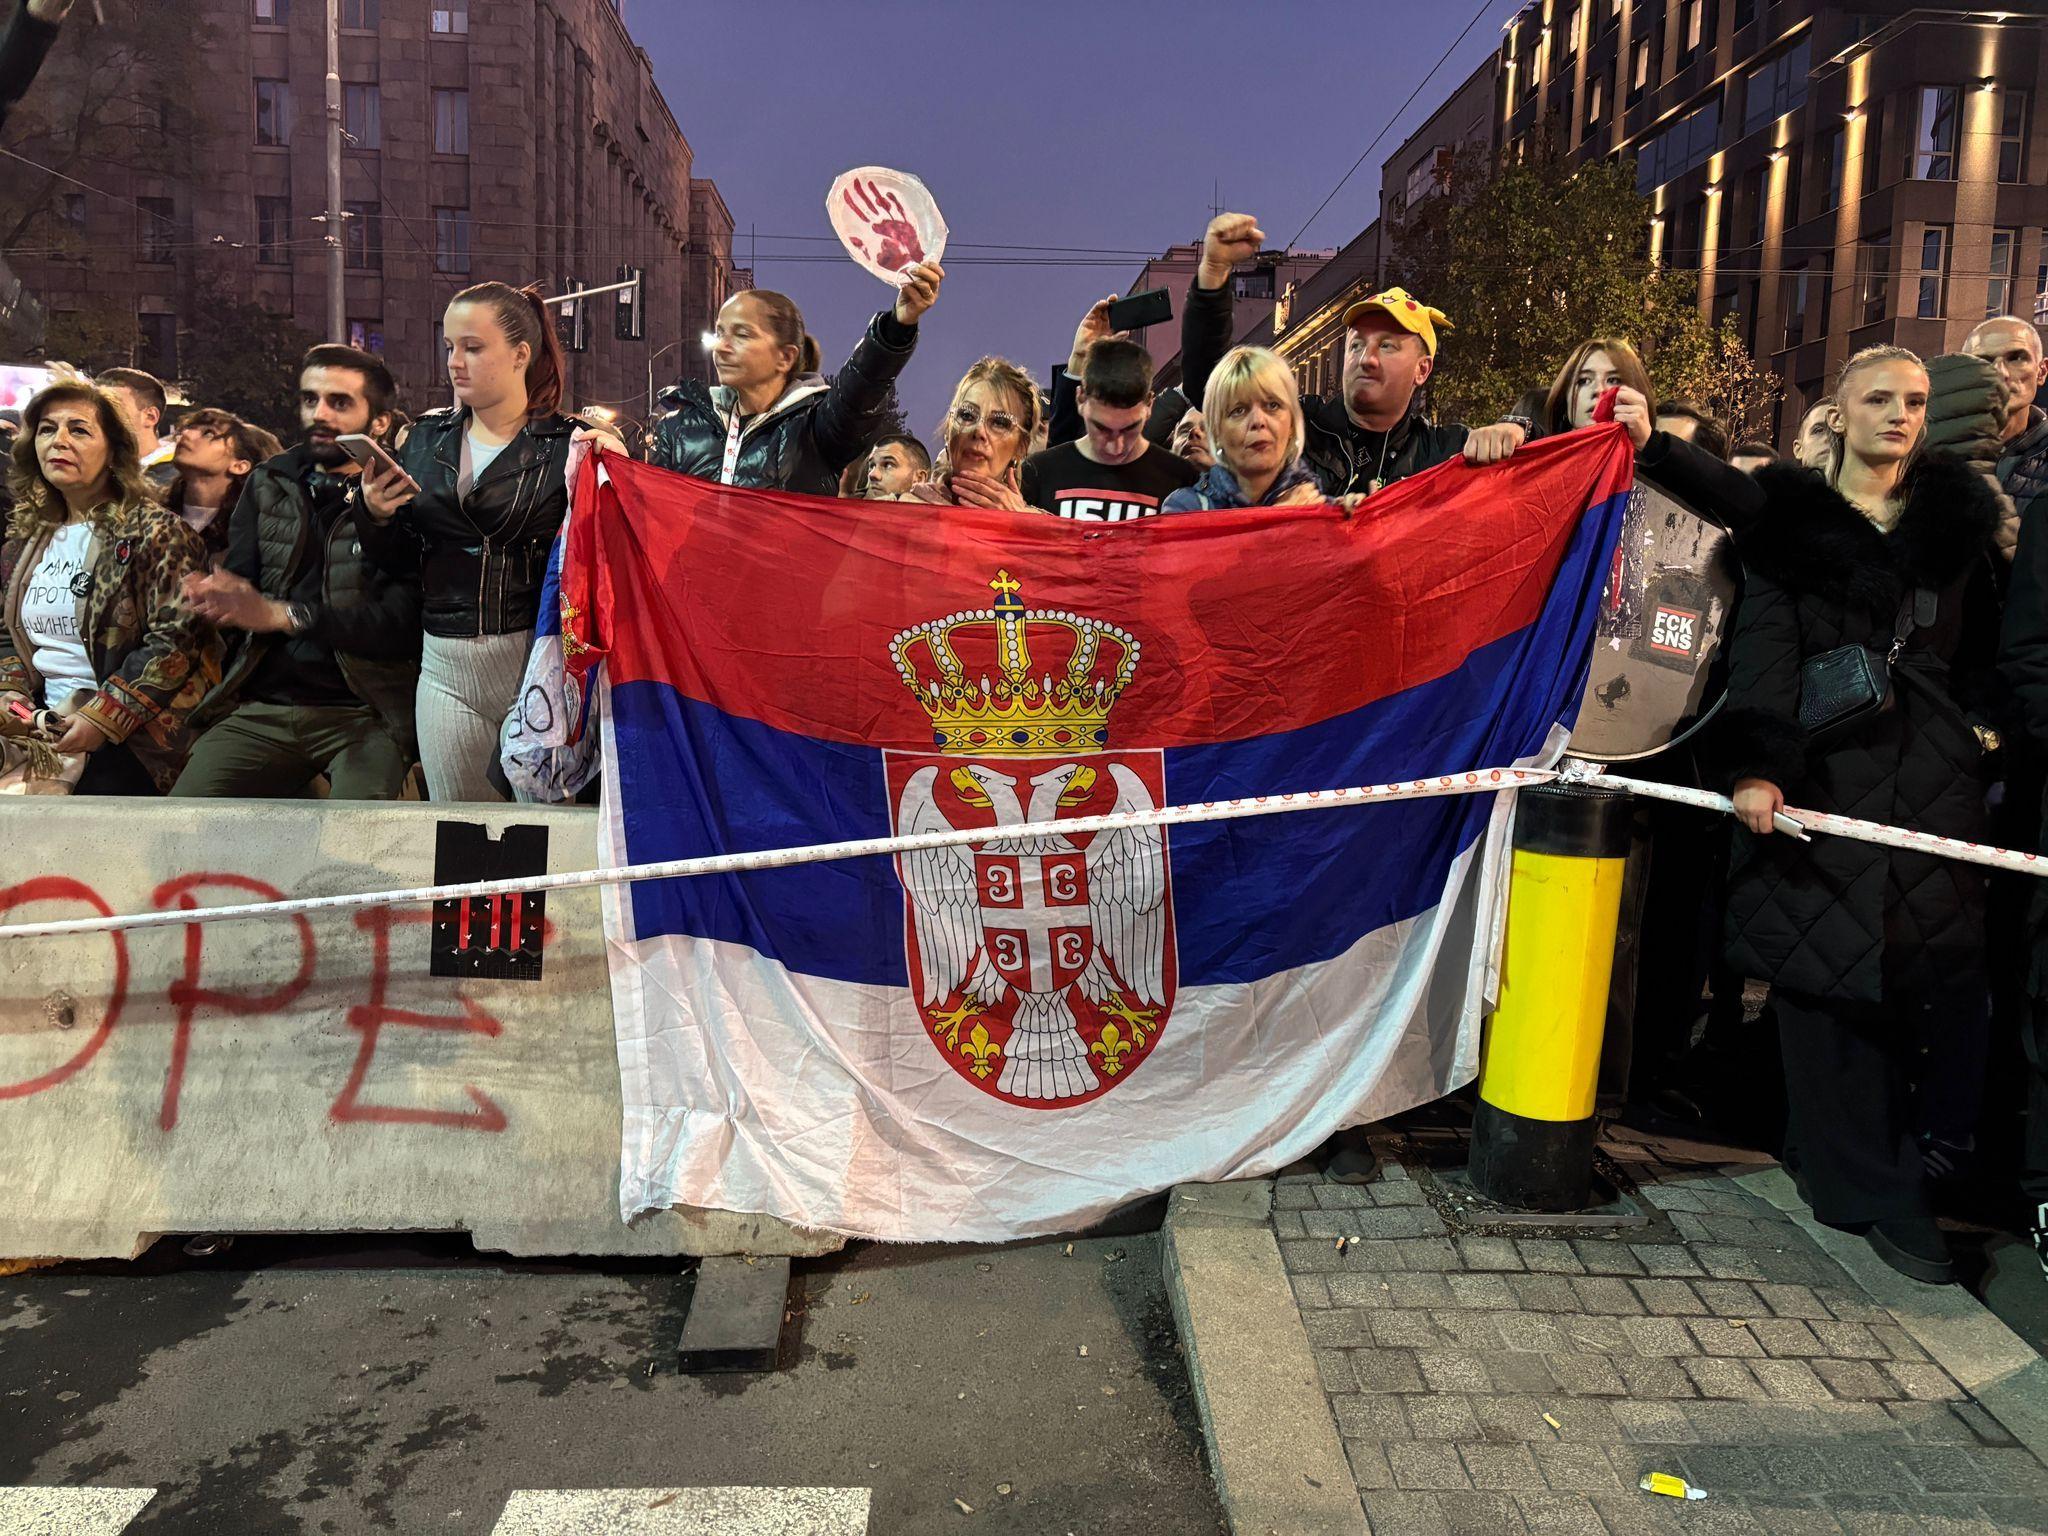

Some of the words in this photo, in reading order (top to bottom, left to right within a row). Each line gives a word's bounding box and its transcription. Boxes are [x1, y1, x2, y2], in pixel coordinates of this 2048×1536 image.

[26, 587, 75, 605] ПРОТ
[1654, 611, 1695, 635] FCK
[1651, 627, 1692, 650] SNS
